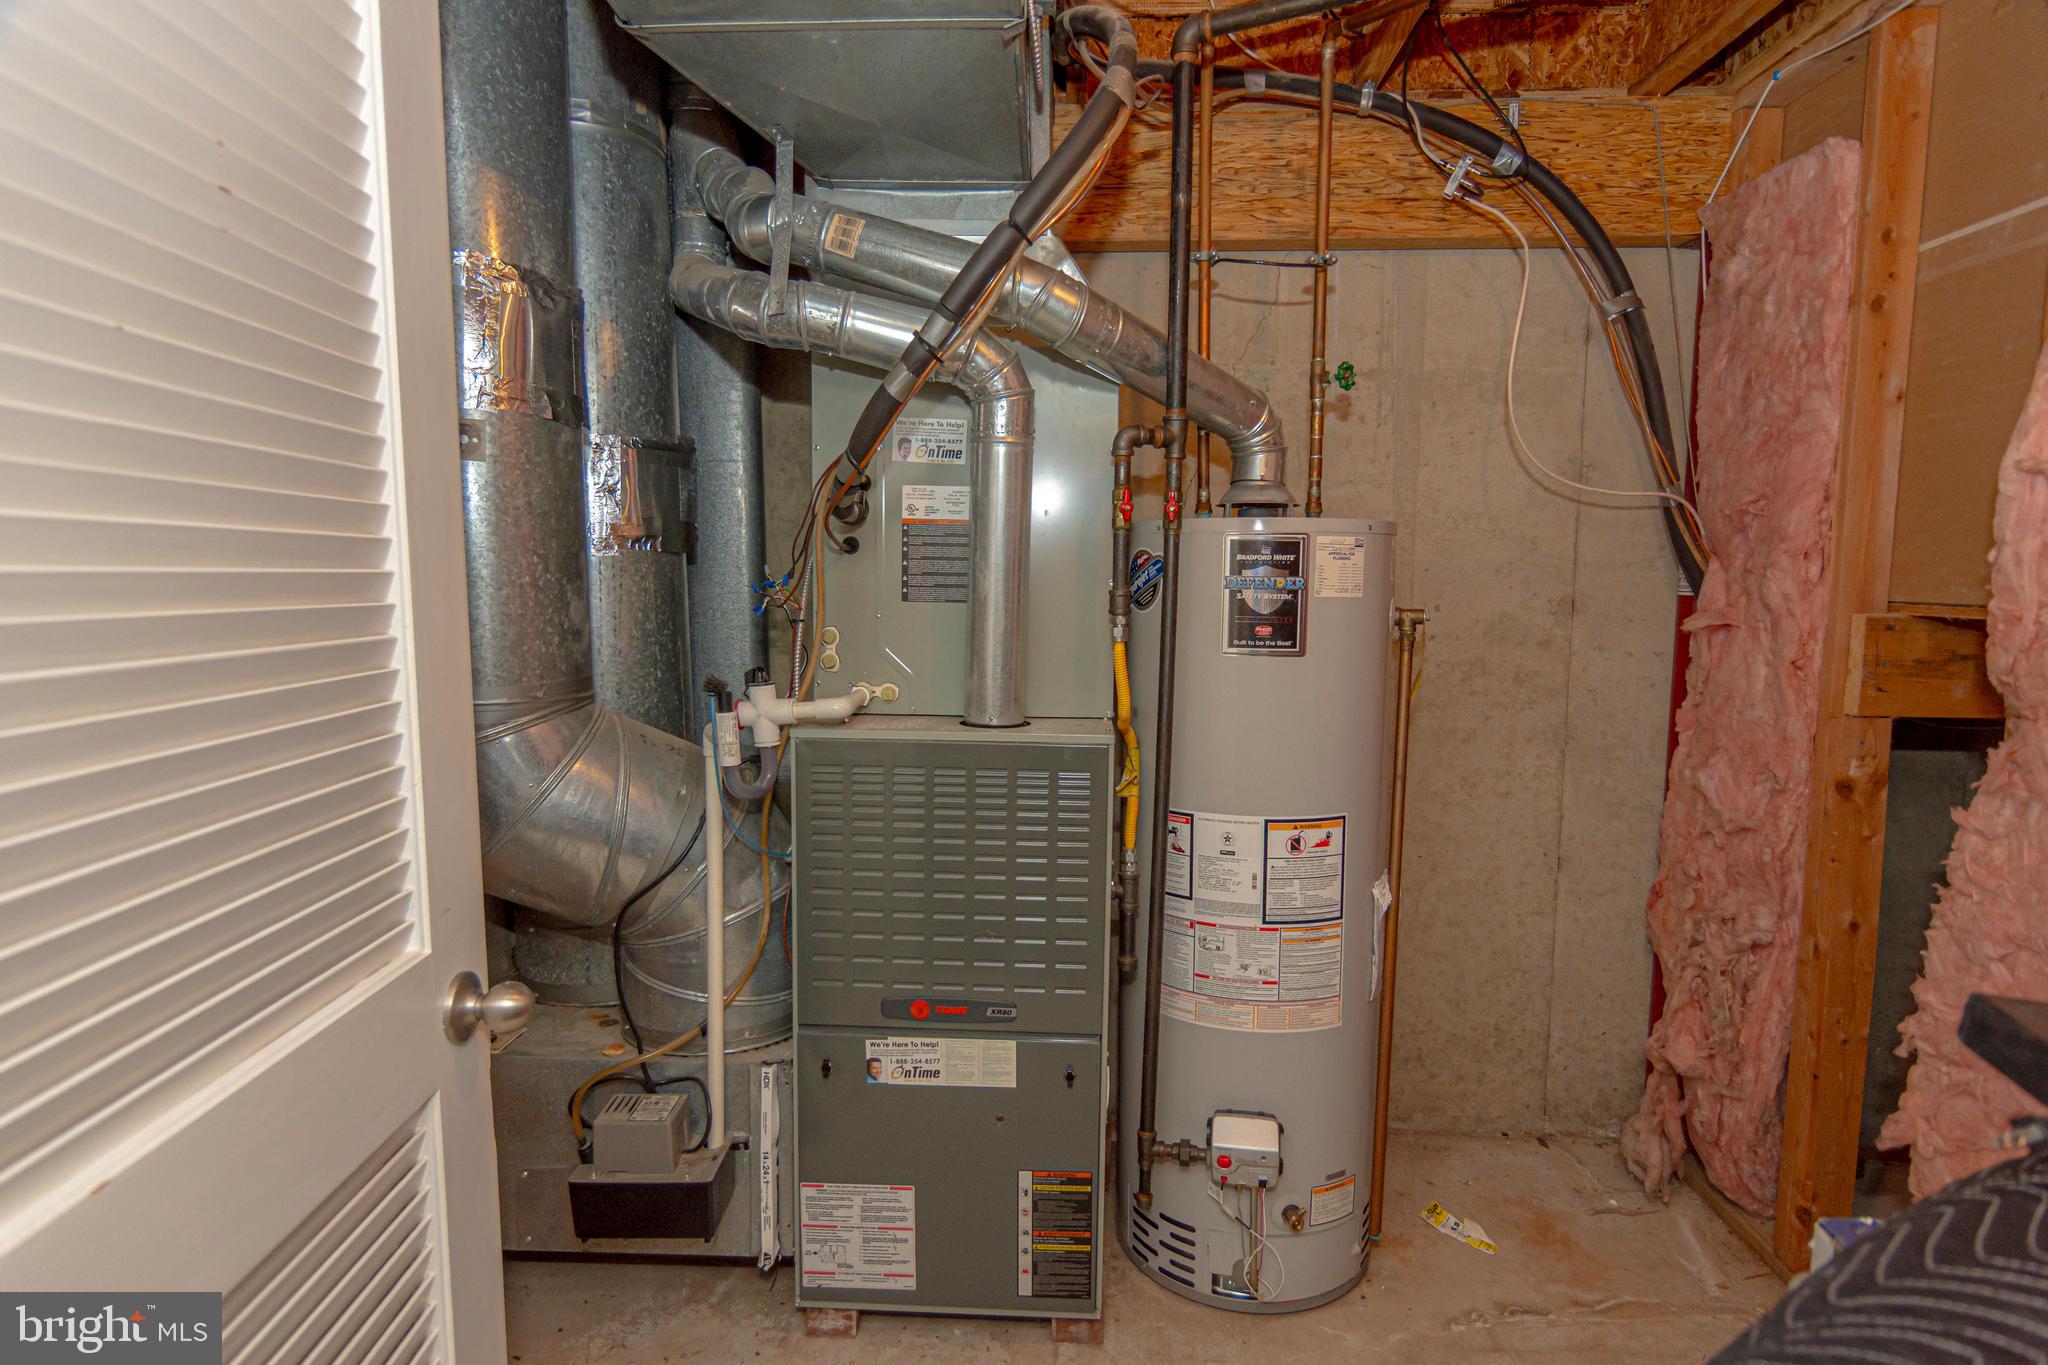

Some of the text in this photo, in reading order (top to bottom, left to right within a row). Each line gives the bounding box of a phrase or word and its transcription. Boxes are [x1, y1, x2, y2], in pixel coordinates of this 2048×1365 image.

[1224, 576, 1305, 590] DEFENDER
[891, 1065, 941, 1079] OnTime
[763, 1165, 769, 1175] 24
